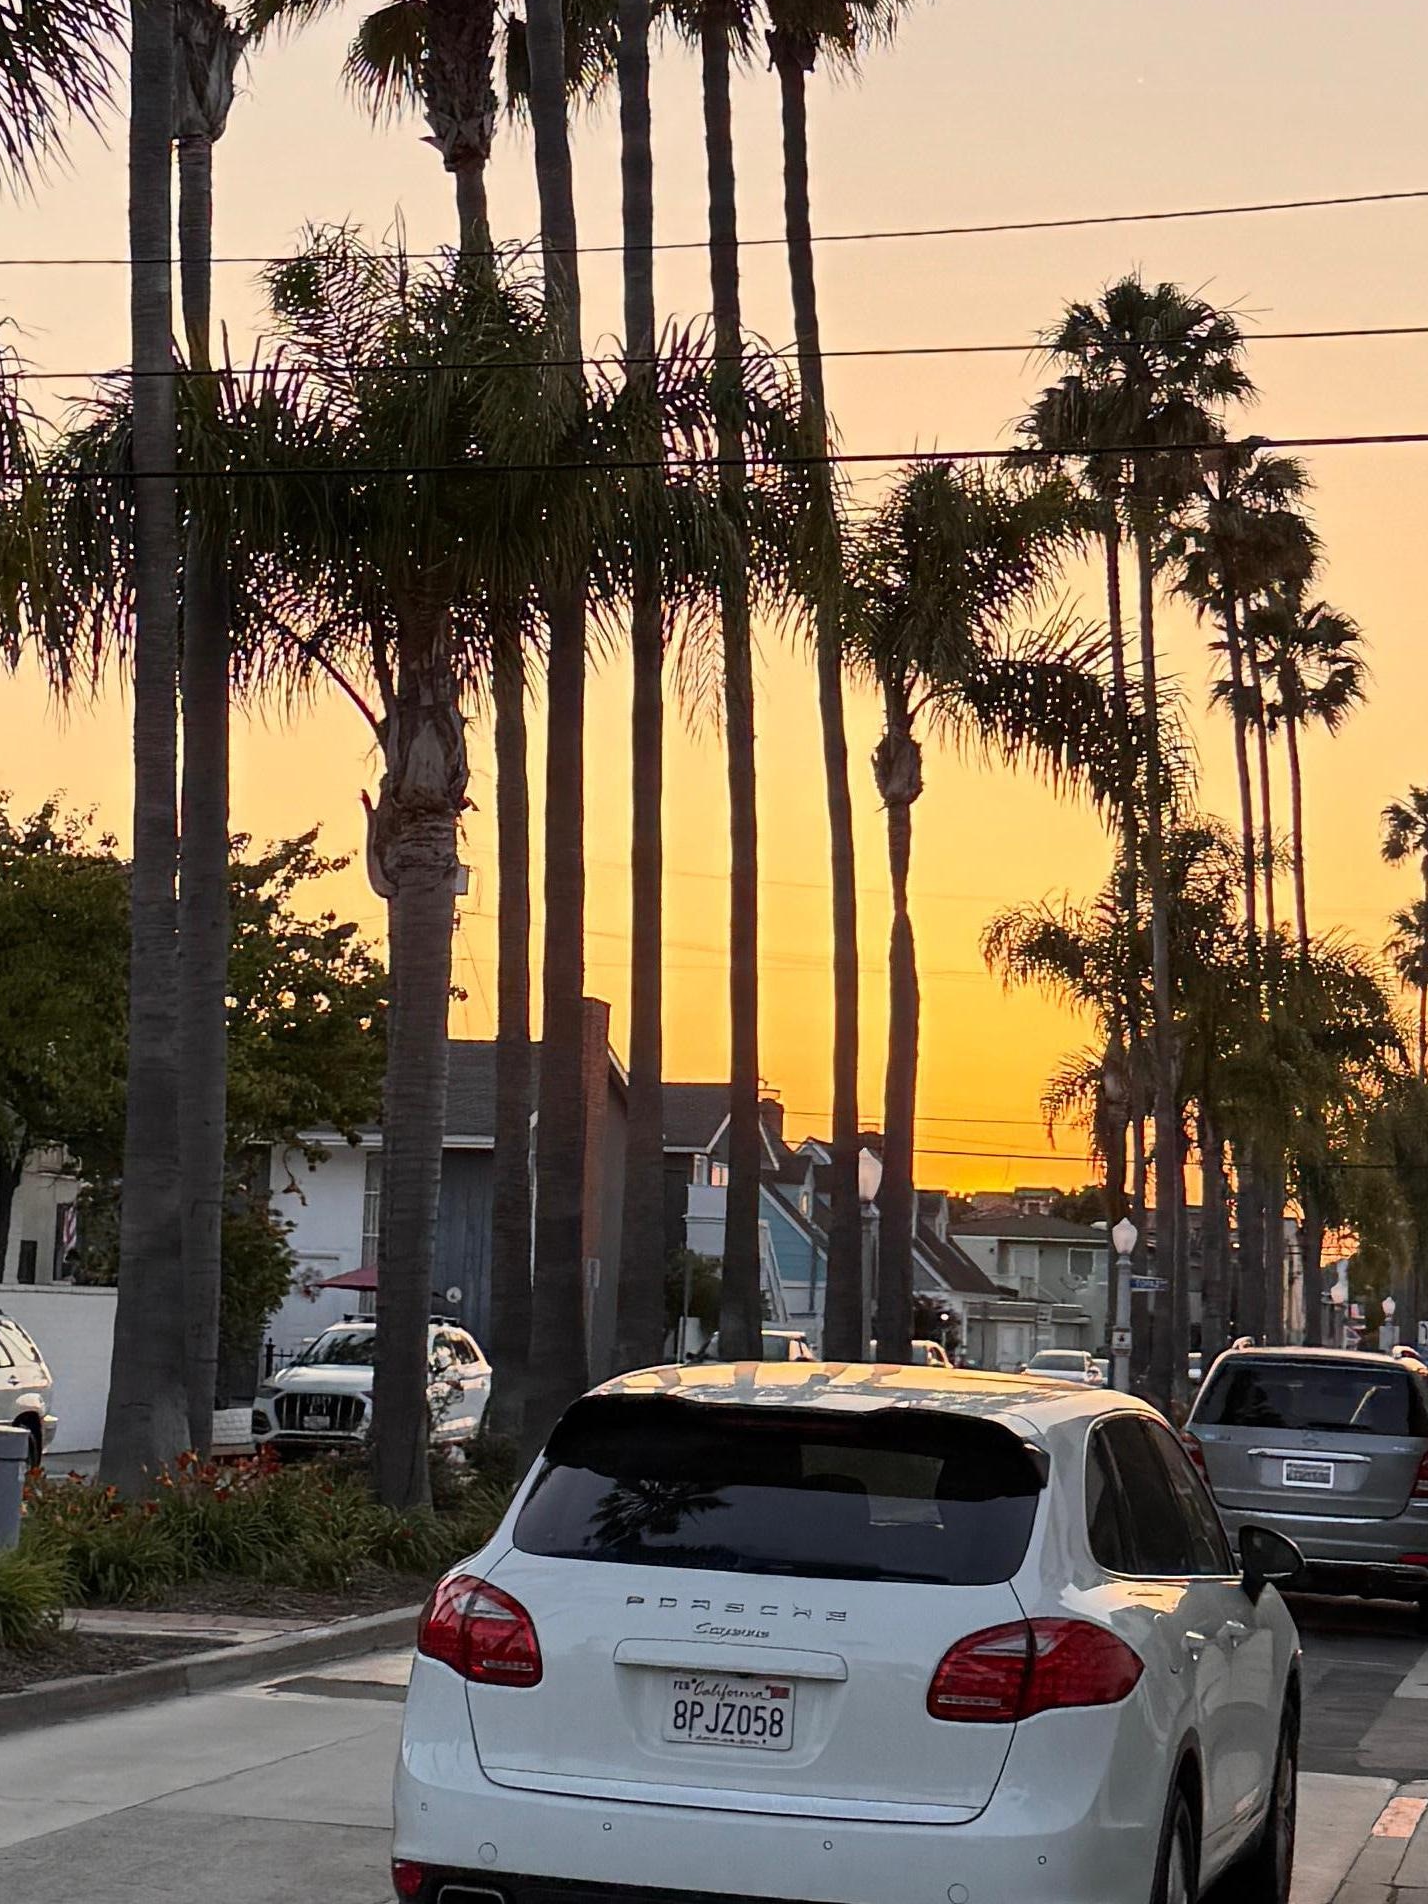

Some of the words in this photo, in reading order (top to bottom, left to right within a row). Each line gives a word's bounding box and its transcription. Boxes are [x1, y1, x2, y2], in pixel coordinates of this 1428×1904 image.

[626, 1596, 847, 1622] PORSCHE
[693, 1680, 770, 1701] California
[673, 1700, 784, 1737] 8PJZ058
